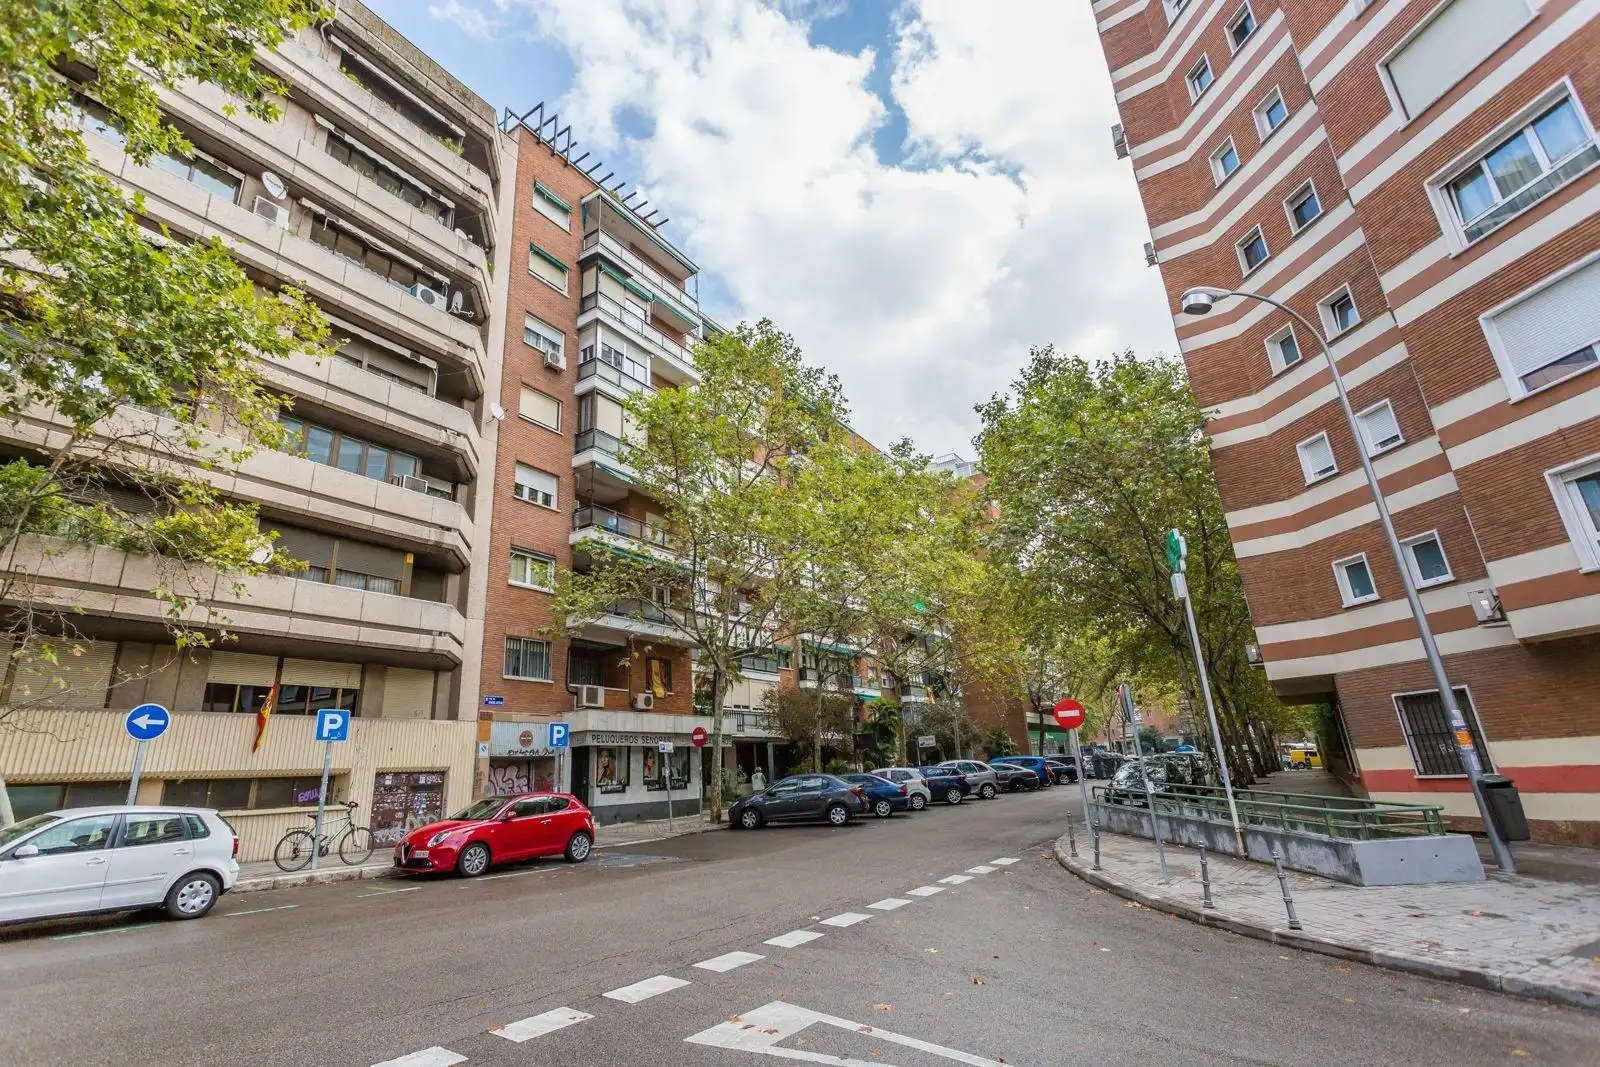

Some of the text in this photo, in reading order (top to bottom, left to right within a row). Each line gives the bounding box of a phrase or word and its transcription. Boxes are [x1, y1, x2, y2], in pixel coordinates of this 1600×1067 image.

[322, 713, 343, 738] P
[552, 725, 566, 745] P
[591, 734, 639, 744] PELUQUEROS
